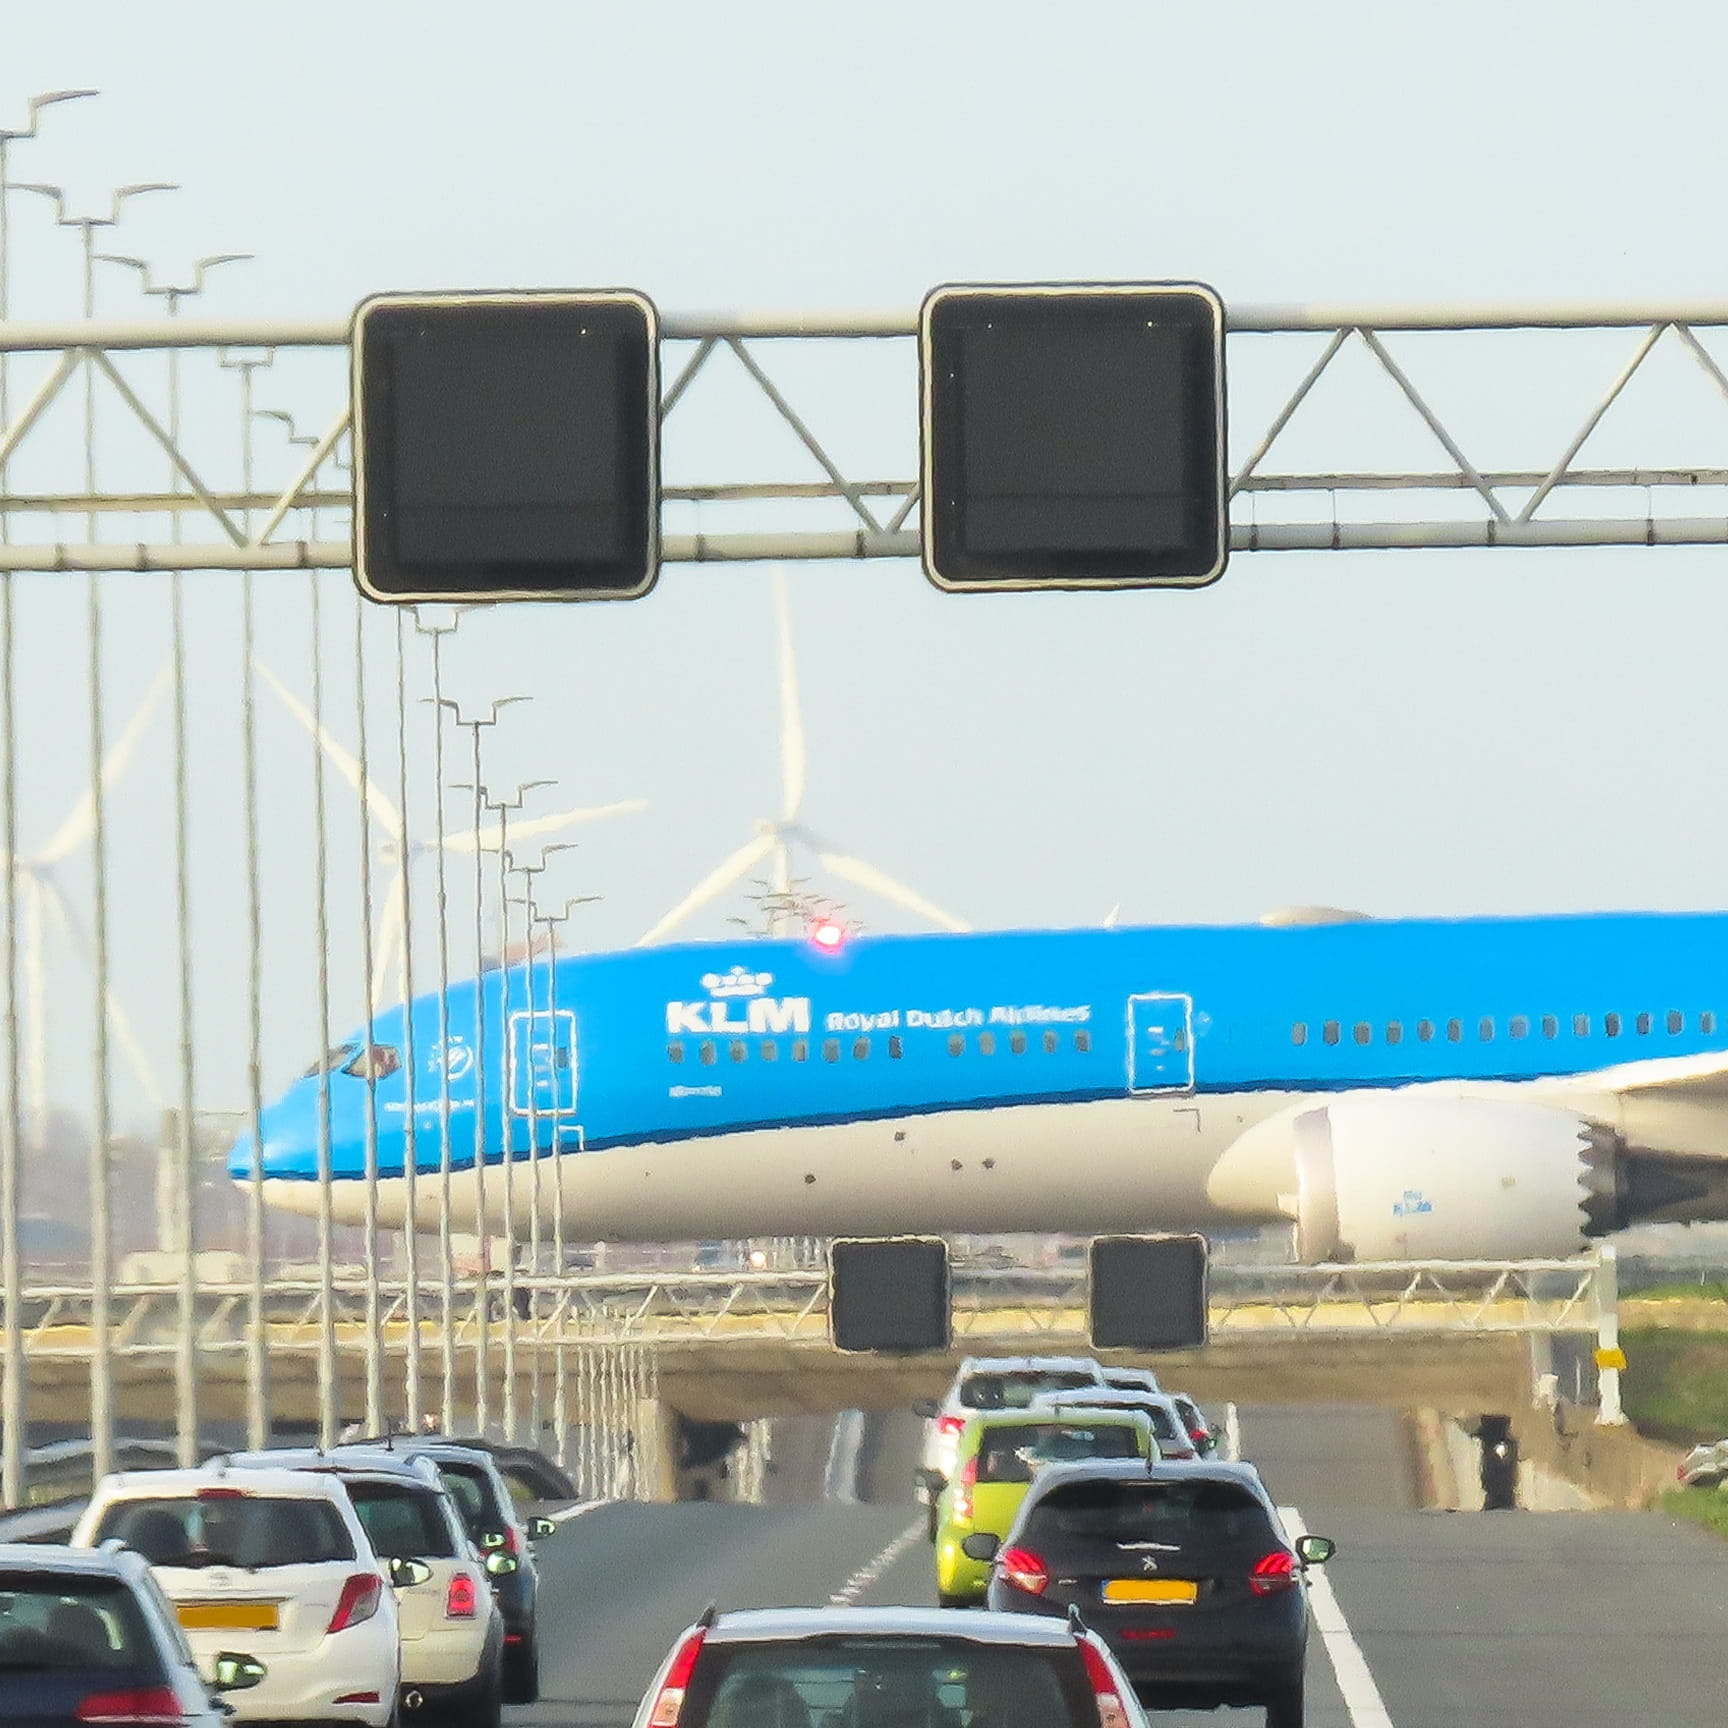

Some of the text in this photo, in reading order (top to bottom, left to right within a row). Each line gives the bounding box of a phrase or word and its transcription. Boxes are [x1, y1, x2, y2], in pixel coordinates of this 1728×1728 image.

[666, 996, 810, 1034] KLM
[826, 1010, 900, 1032] Royal
[906, 1008, 983, 1028] Dutch
